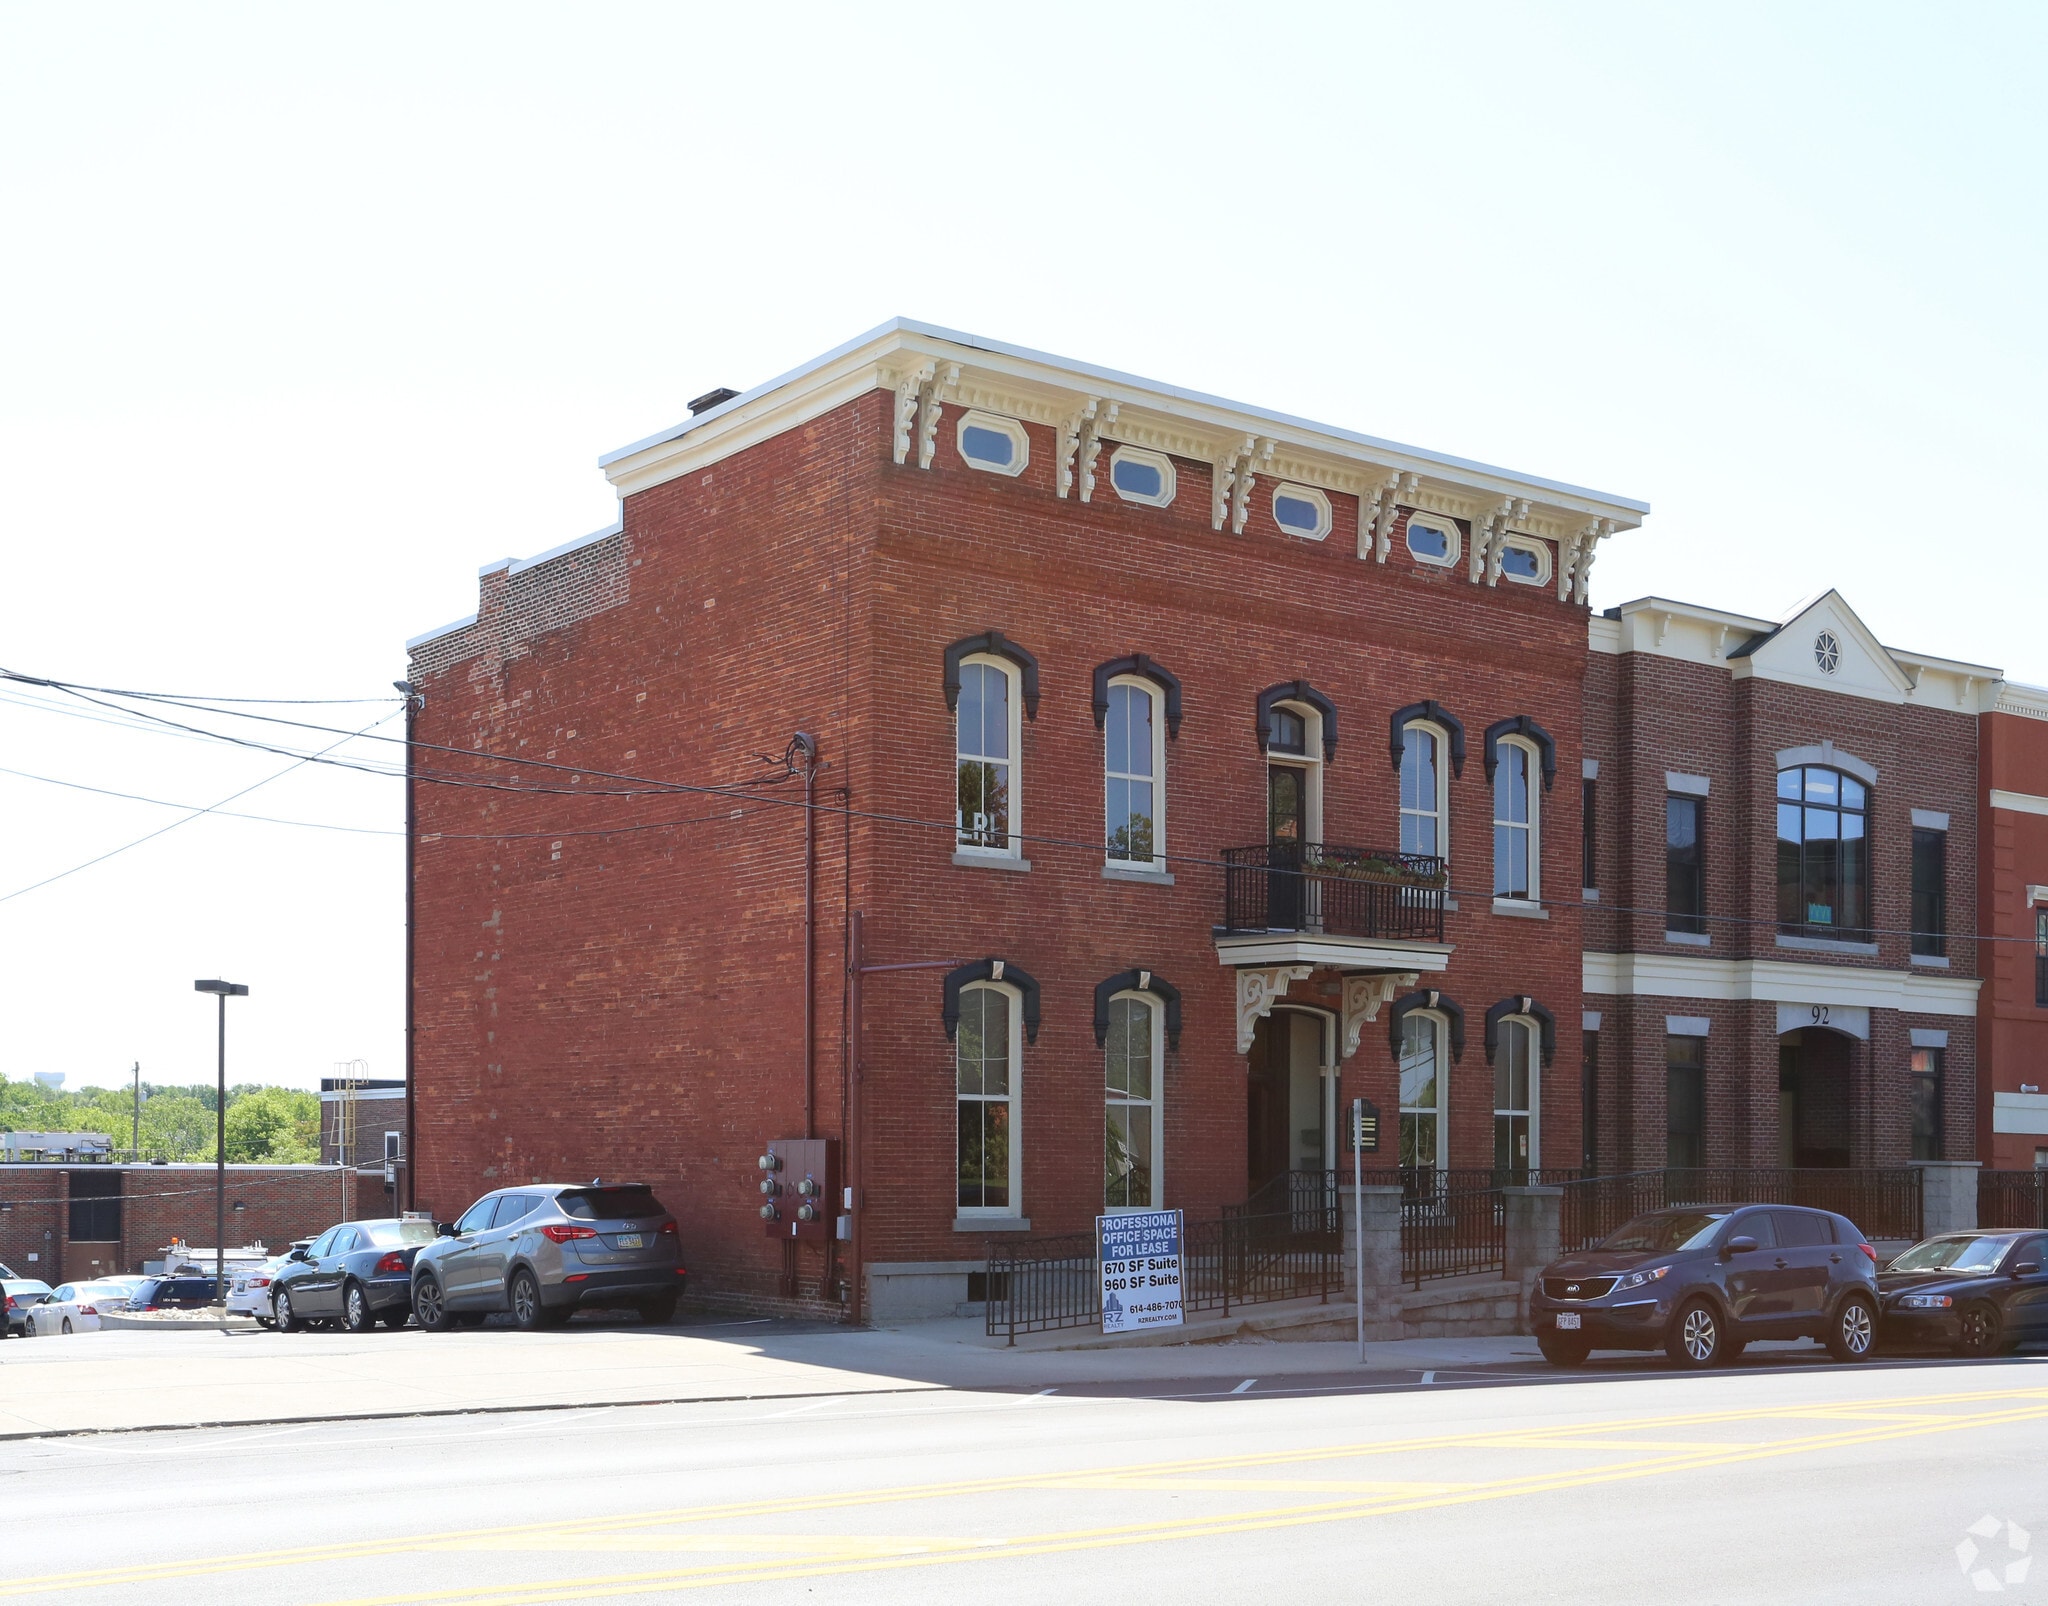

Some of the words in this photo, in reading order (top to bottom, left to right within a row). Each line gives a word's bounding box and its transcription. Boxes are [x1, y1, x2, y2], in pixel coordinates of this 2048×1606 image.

[1811, 1005, 1830, 1025] 92
[1102, 1230, 1141, 1245] OFFICE
[1143, 1227, 1178, 1241] SPACE
[1112, 1244, 1134, 1258] FOR
[1135, 1241, 1169, 1255] LEASE
[1105, 1262, 1125, 1274] 670
[1128, 1260, 1145, 1273] SF
[1148, 1257, 1178, 1271] Suite
[1105, 1278, 1126, 1291] 960
[1129, 1276, 1146, 1289] SF
[1149, 1273, 1179, 1287] Suite
[1130, 1300, 1183, 1314] 614-486-7070
[1104, 1312, 1124, 1323] RZ
[1138, 1314, 1177, 1323] RZREALTY.COM
